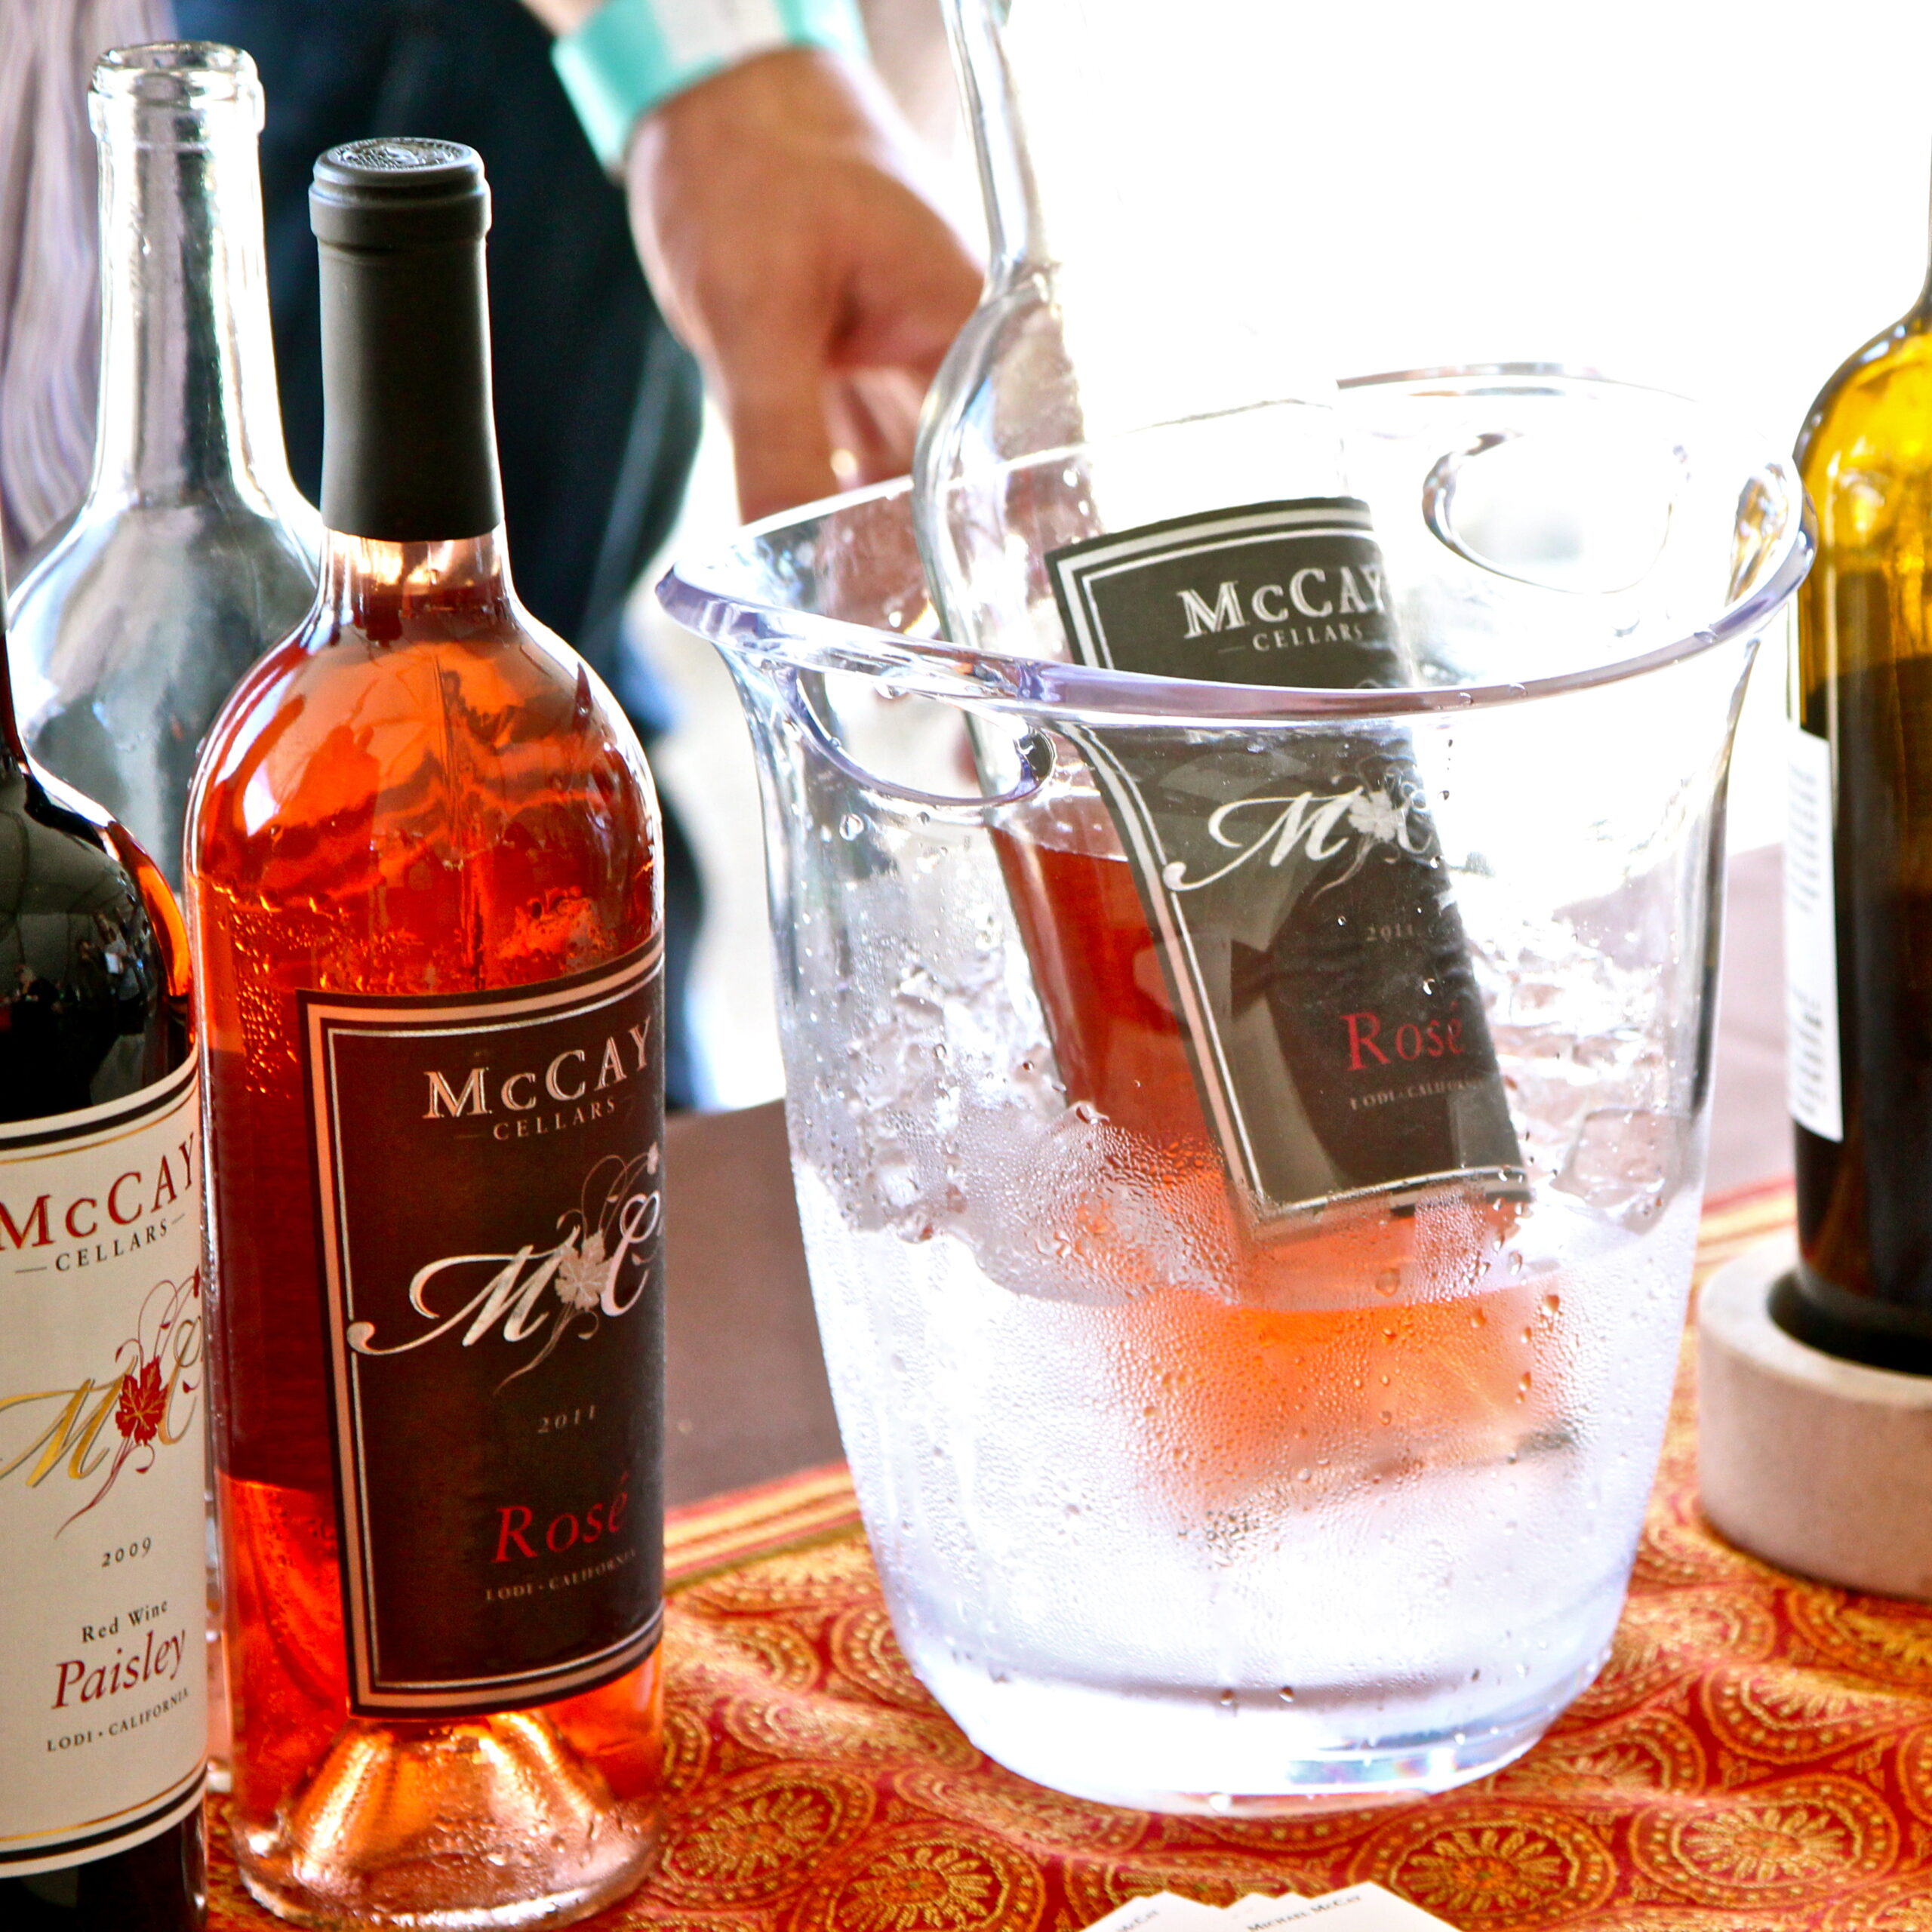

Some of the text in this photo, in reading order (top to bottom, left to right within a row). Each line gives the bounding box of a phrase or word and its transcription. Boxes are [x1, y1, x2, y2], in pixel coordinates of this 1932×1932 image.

[1252, 622, 1363, 653] CELLARS
[1366, 923, 1414, 943] 2011
[493, 1097, 616, 1141] CELLARS
[55, 1217, 168, 1272] CELLARS
[537, 1404, 596, 1435] 2011
[101, 1537, 152, 1568] 2009
[82, 1600, 168, 1644] Red Wine
[51, 1629, 186, 1710] Paisley
